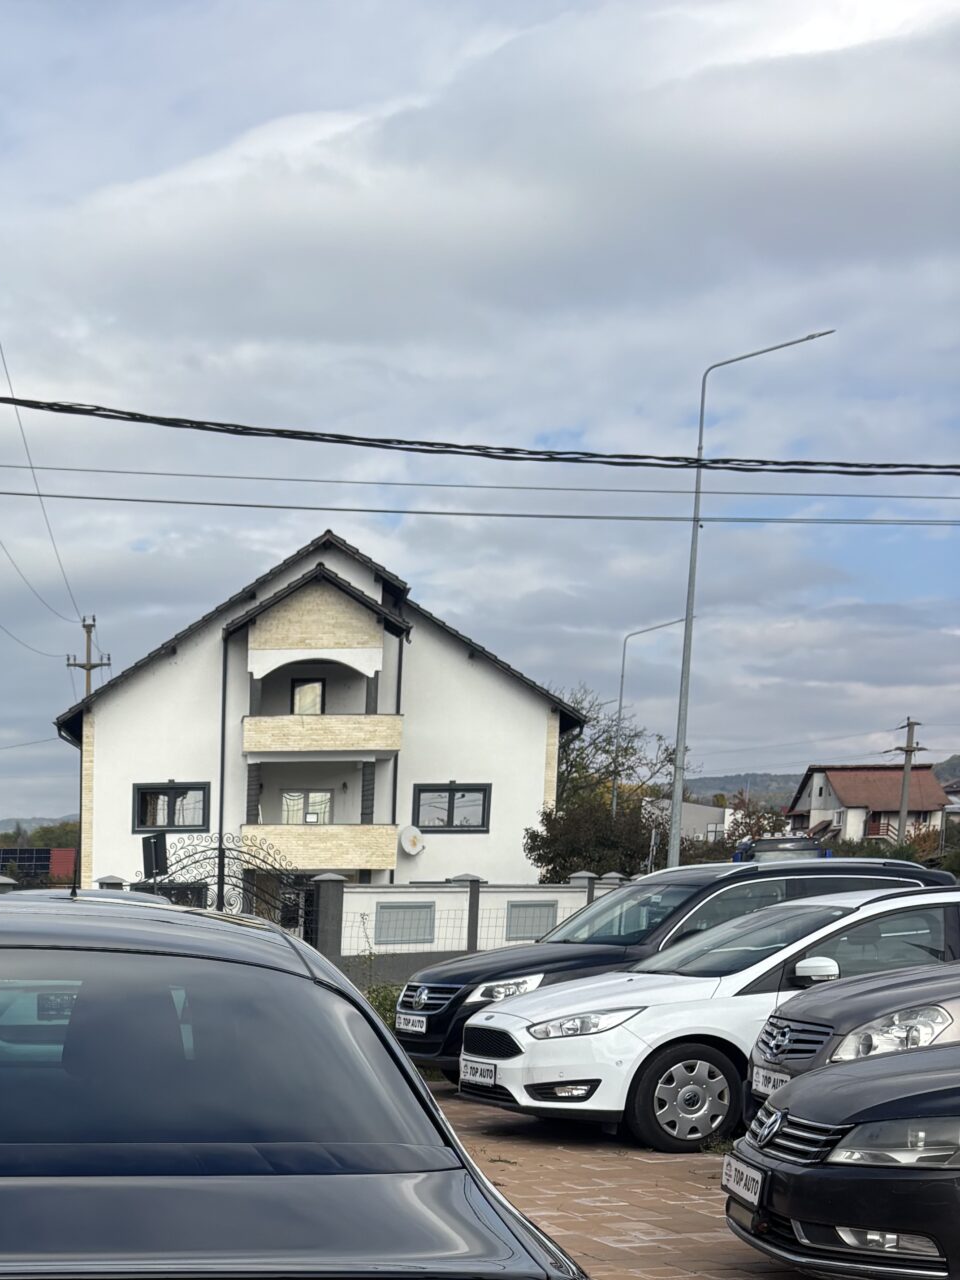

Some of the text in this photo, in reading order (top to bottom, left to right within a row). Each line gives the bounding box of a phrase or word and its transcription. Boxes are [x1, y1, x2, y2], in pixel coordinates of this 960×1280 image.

[411, 1019, 425, 1029] AUTO
[469, 1066, 494, 1080] TOP AUTO
[761, 1074, 772, 1089] TOP
[733, 1167, 760, 1197] TOP AUTO
